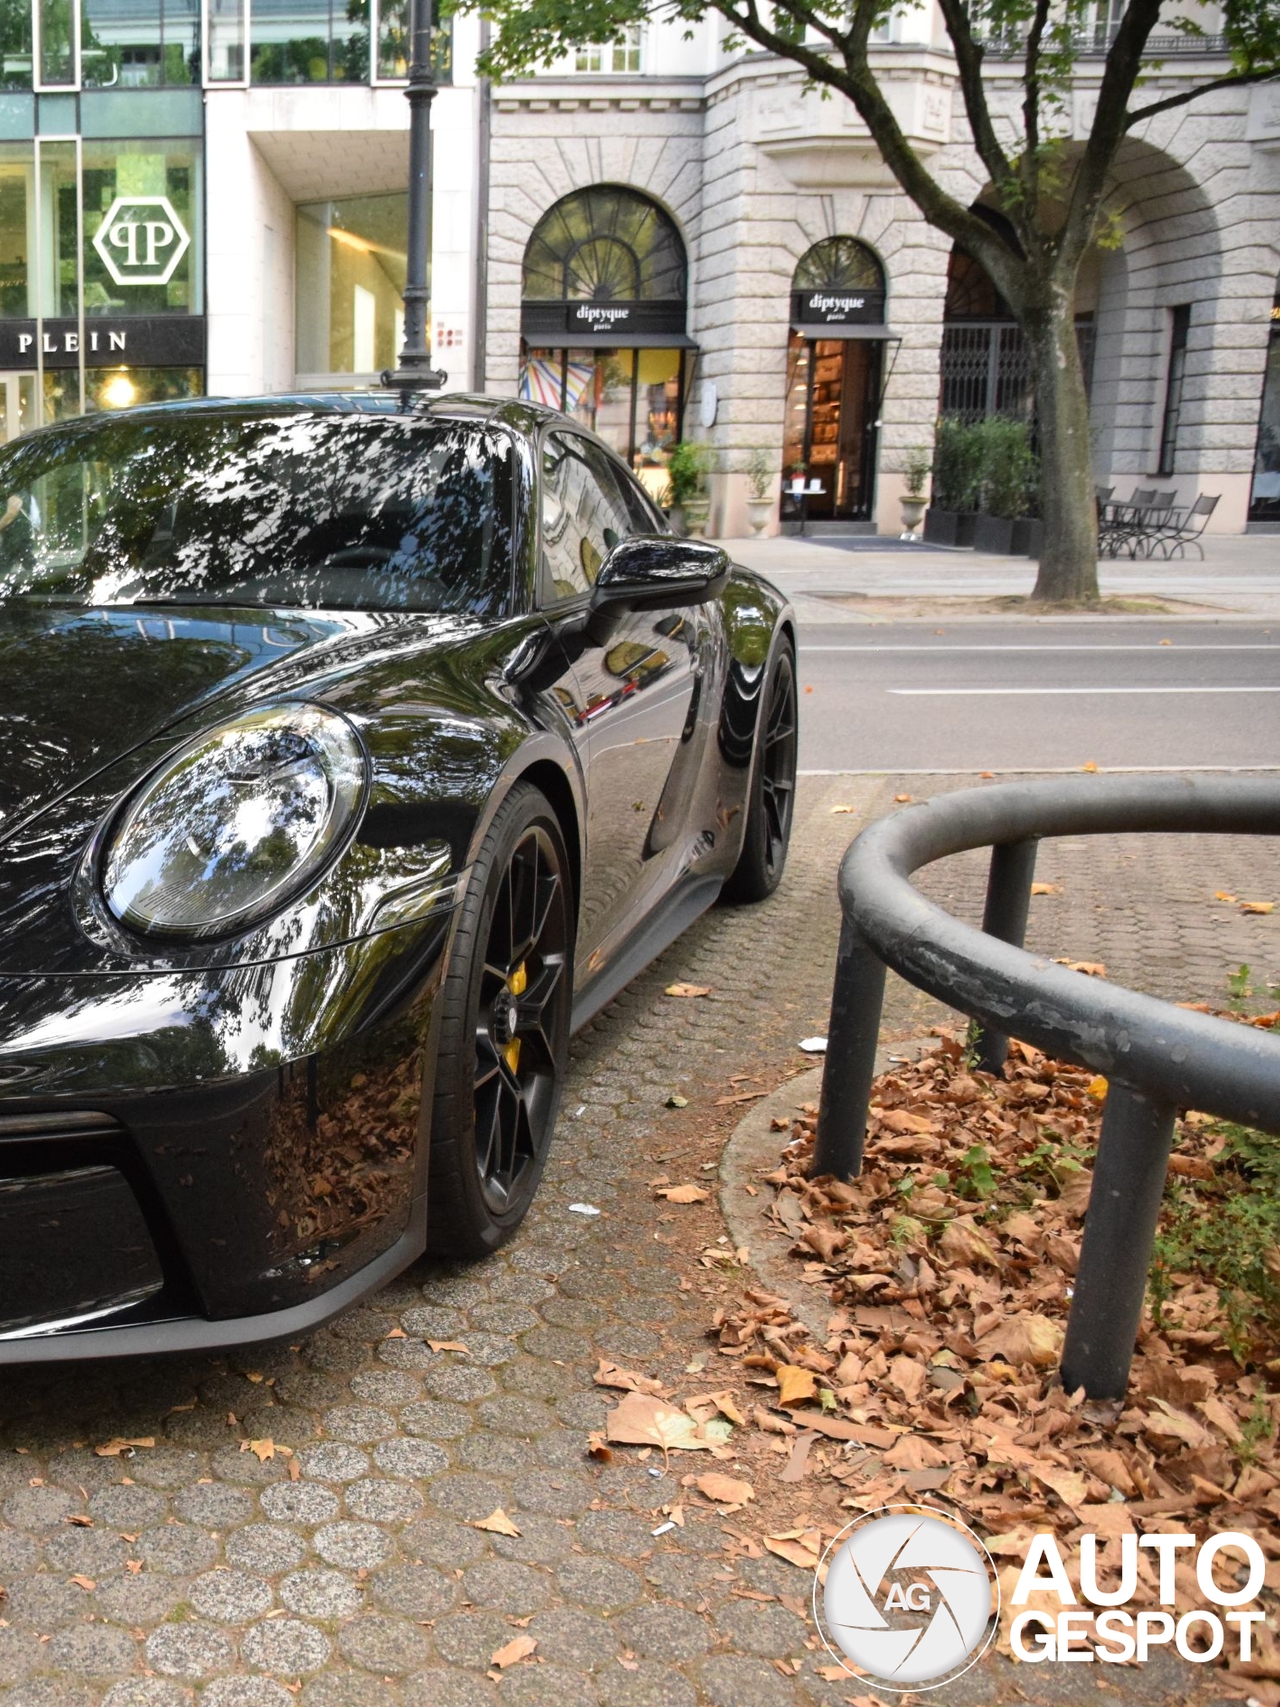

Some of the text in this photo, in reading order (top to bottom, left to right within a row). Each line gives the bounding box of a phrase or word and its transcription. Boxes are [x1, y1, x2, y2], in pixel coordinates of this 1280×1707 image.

[809, 293, 865, 312] diptyque
[576, 304, 630, 323] diptyque
[19, 332, 128, 354] PLEIN
